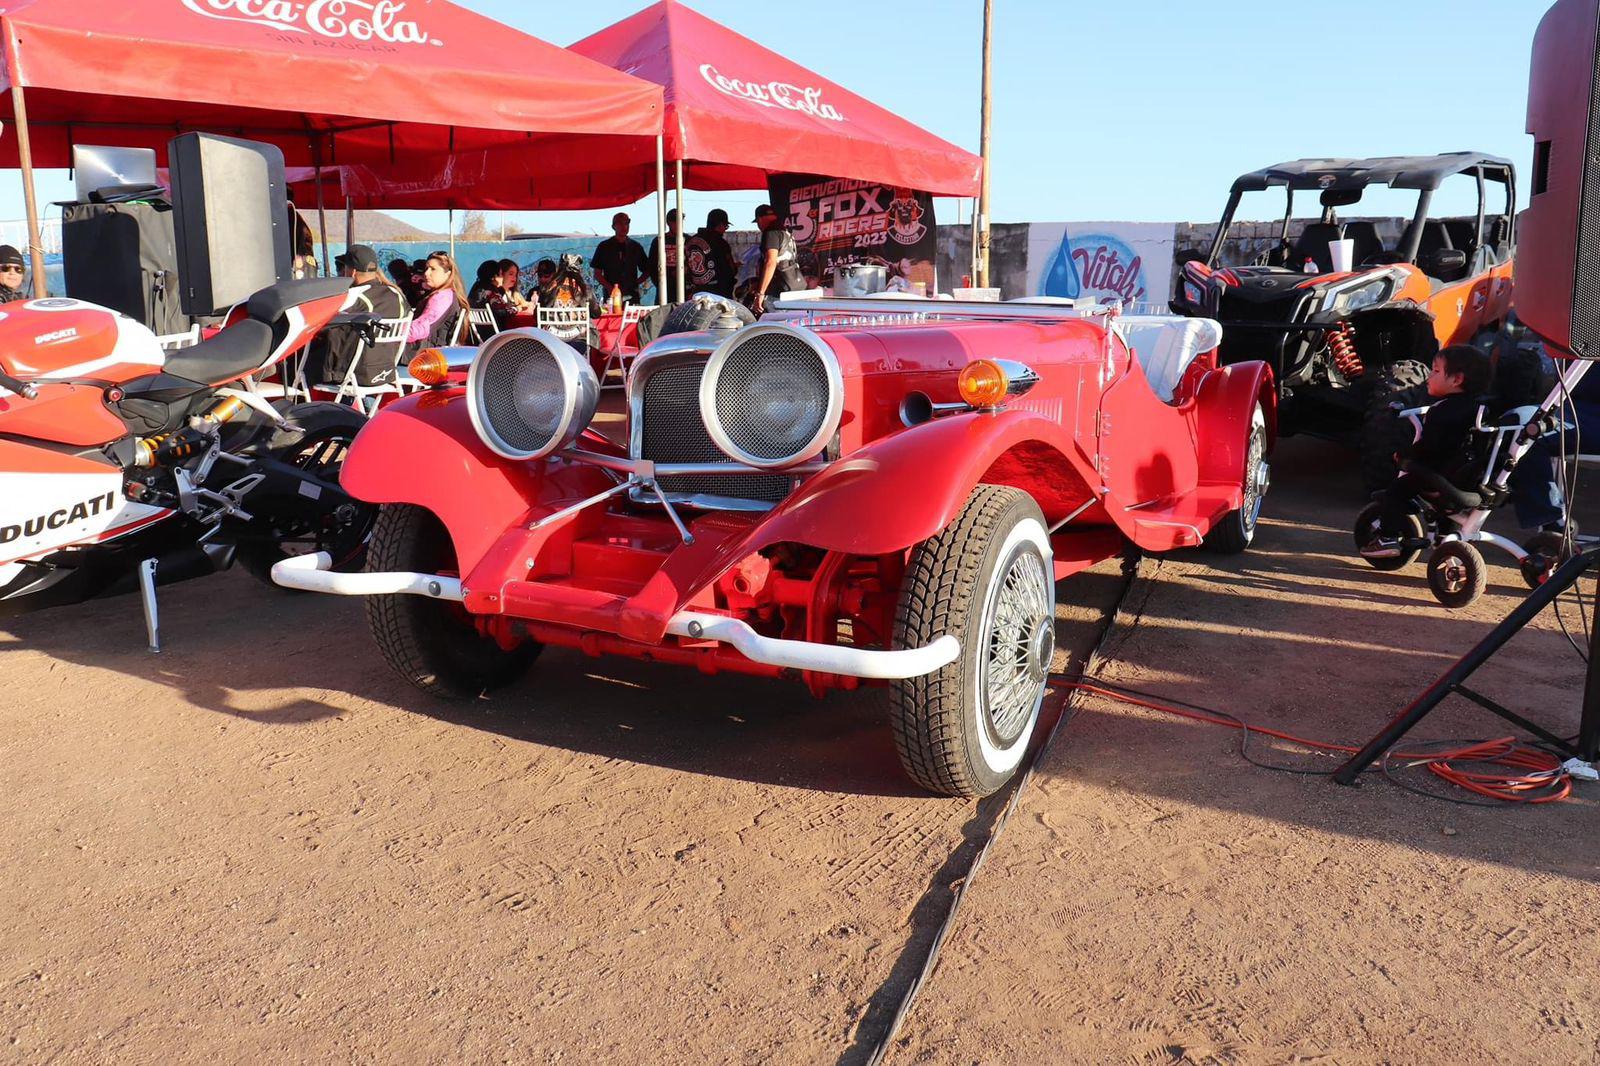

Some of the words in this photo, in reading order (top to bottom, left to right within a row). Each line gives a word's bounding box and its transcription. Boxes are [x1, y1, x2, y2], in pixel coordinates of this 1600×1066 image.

[312, 39, 400, 54] AZUCAR
[699, 64, 844, 121] Coca-Cola
[818, 186, 885, 223] FOX
[819, 216, 888, 239] RIDERS
[854, 231, 888, 248] 2023
[34, 327, 77, 345] DUCATI
[0, 491, 115, 544] DUCATI
